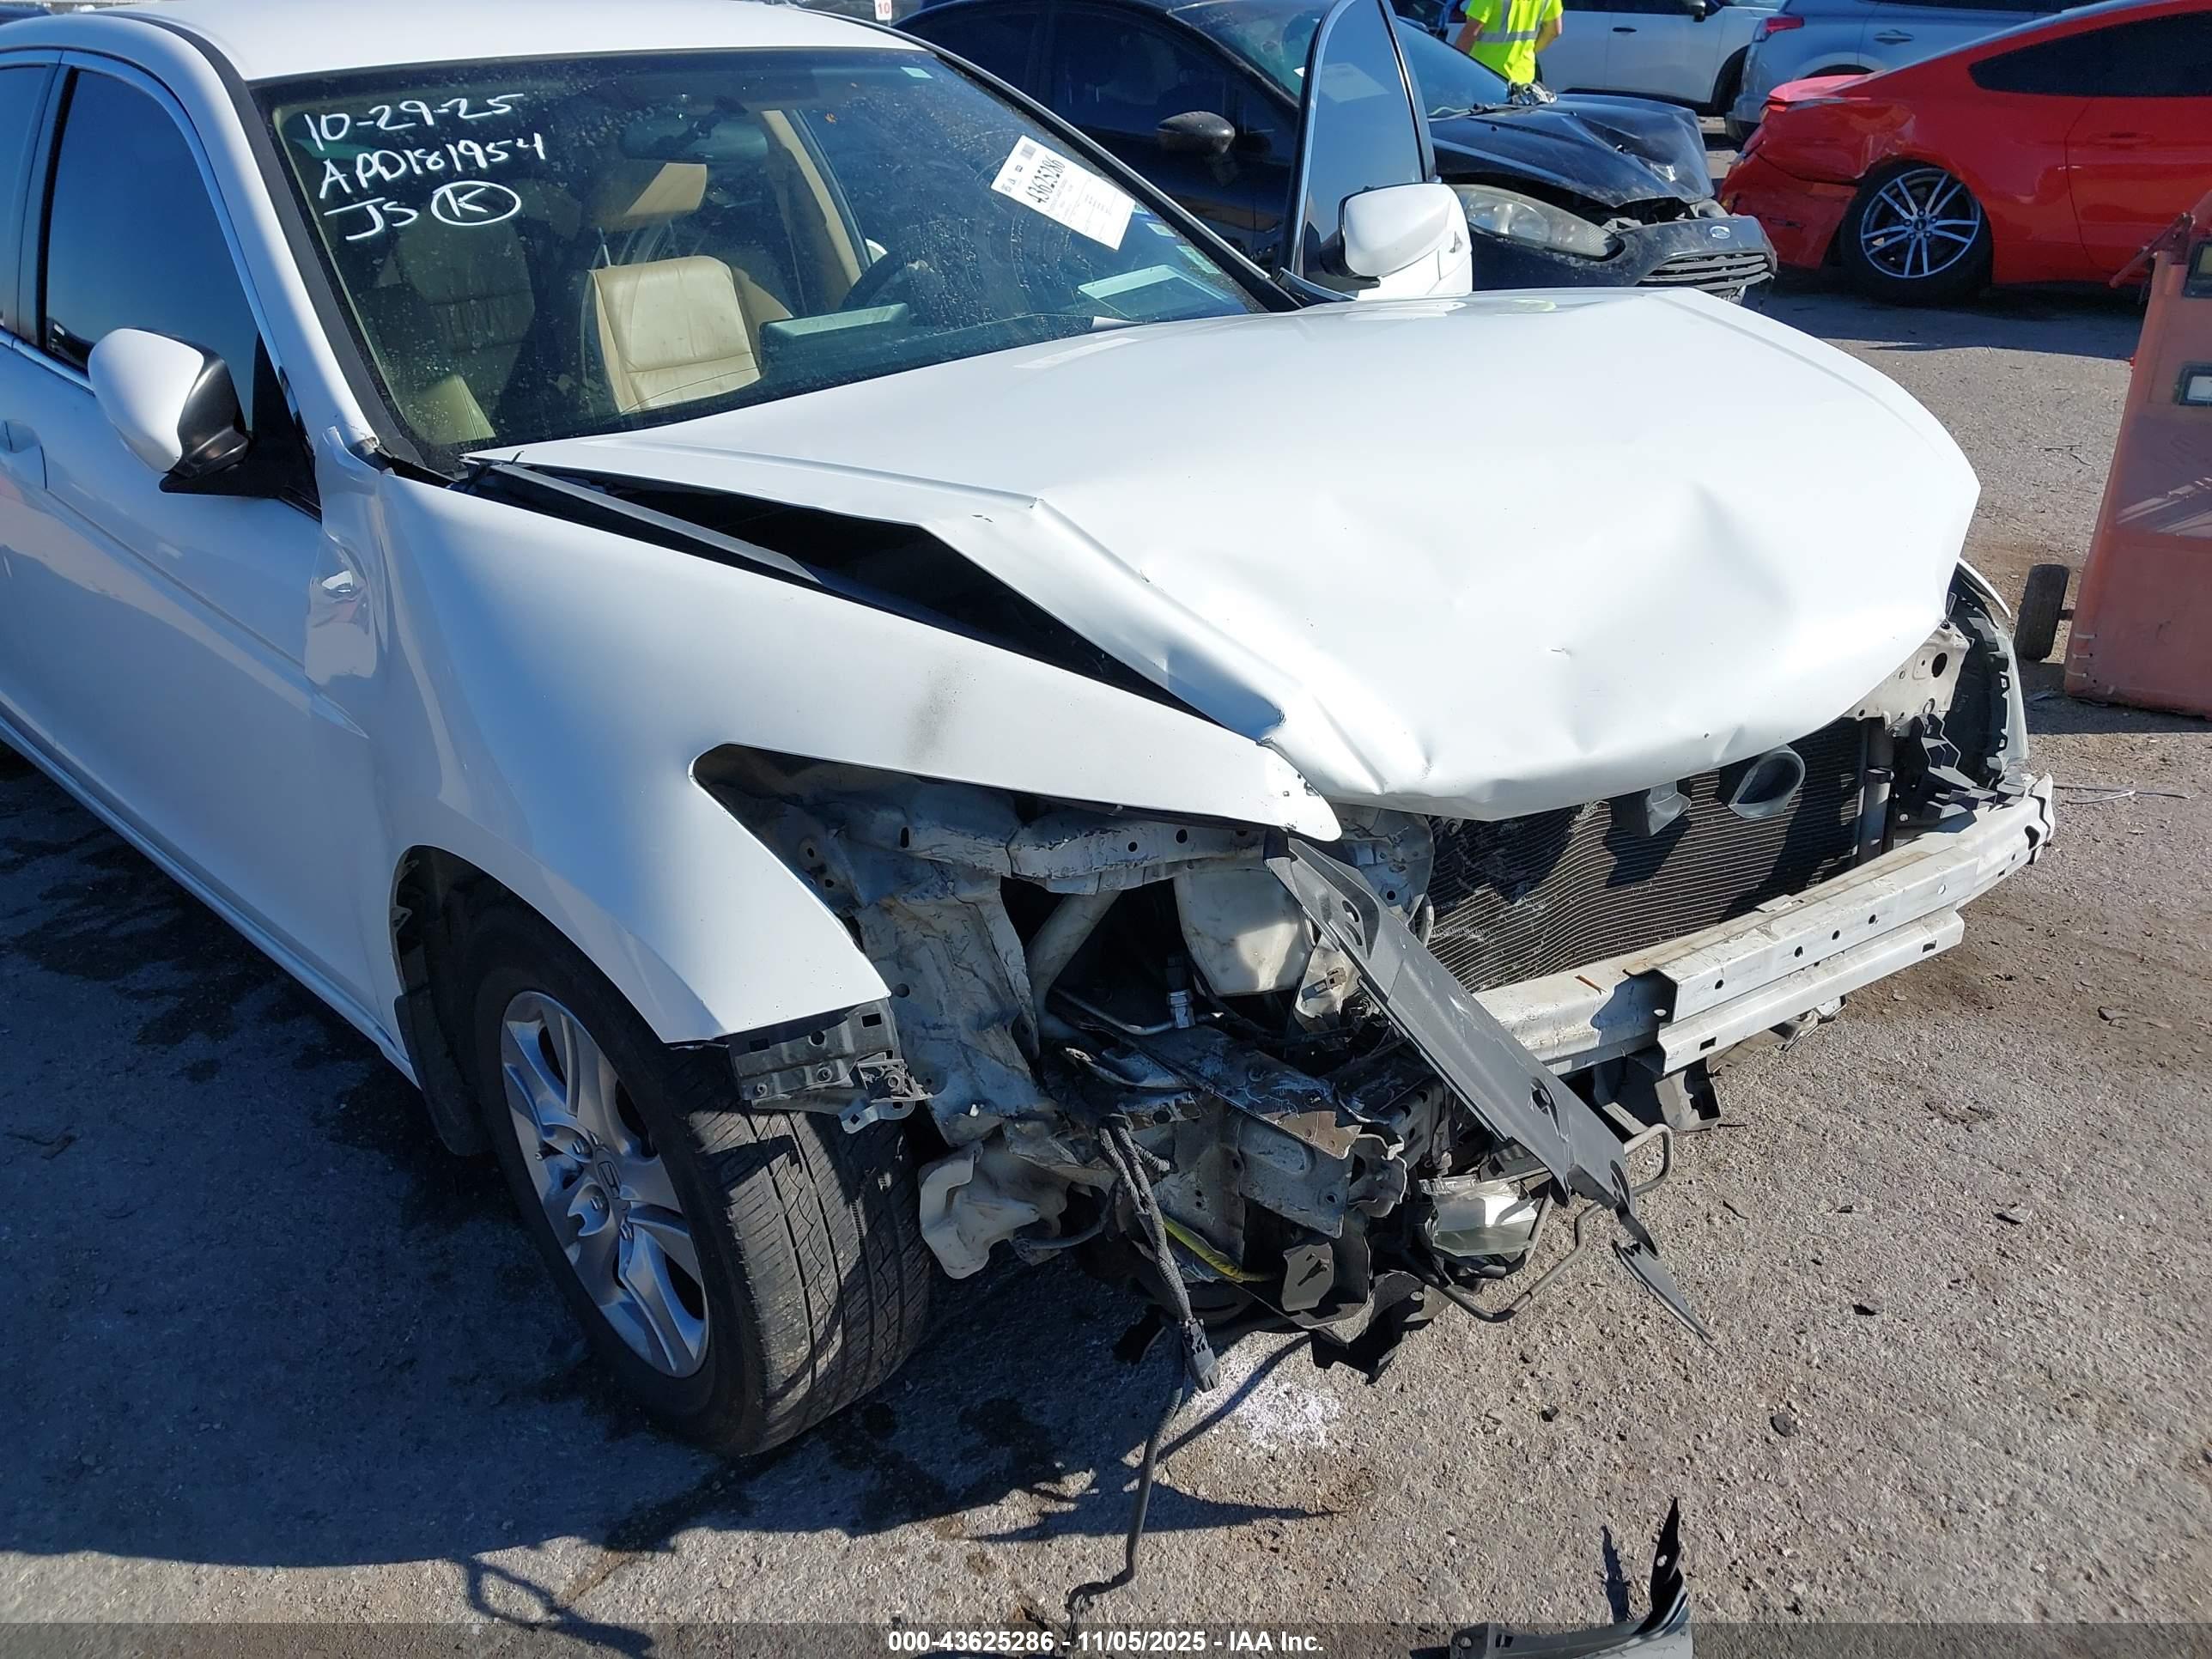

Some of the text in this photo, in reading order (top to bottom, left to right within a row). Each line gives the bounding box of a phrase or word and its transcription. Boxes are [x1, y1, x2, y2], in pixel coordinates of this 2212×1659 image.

[878, 3, 890, 14] 10
[304, 94, 525, 151] 10-29-25
[1026, 155, 1065, 203] 43625286
[324, 197, 420, 240] JS
